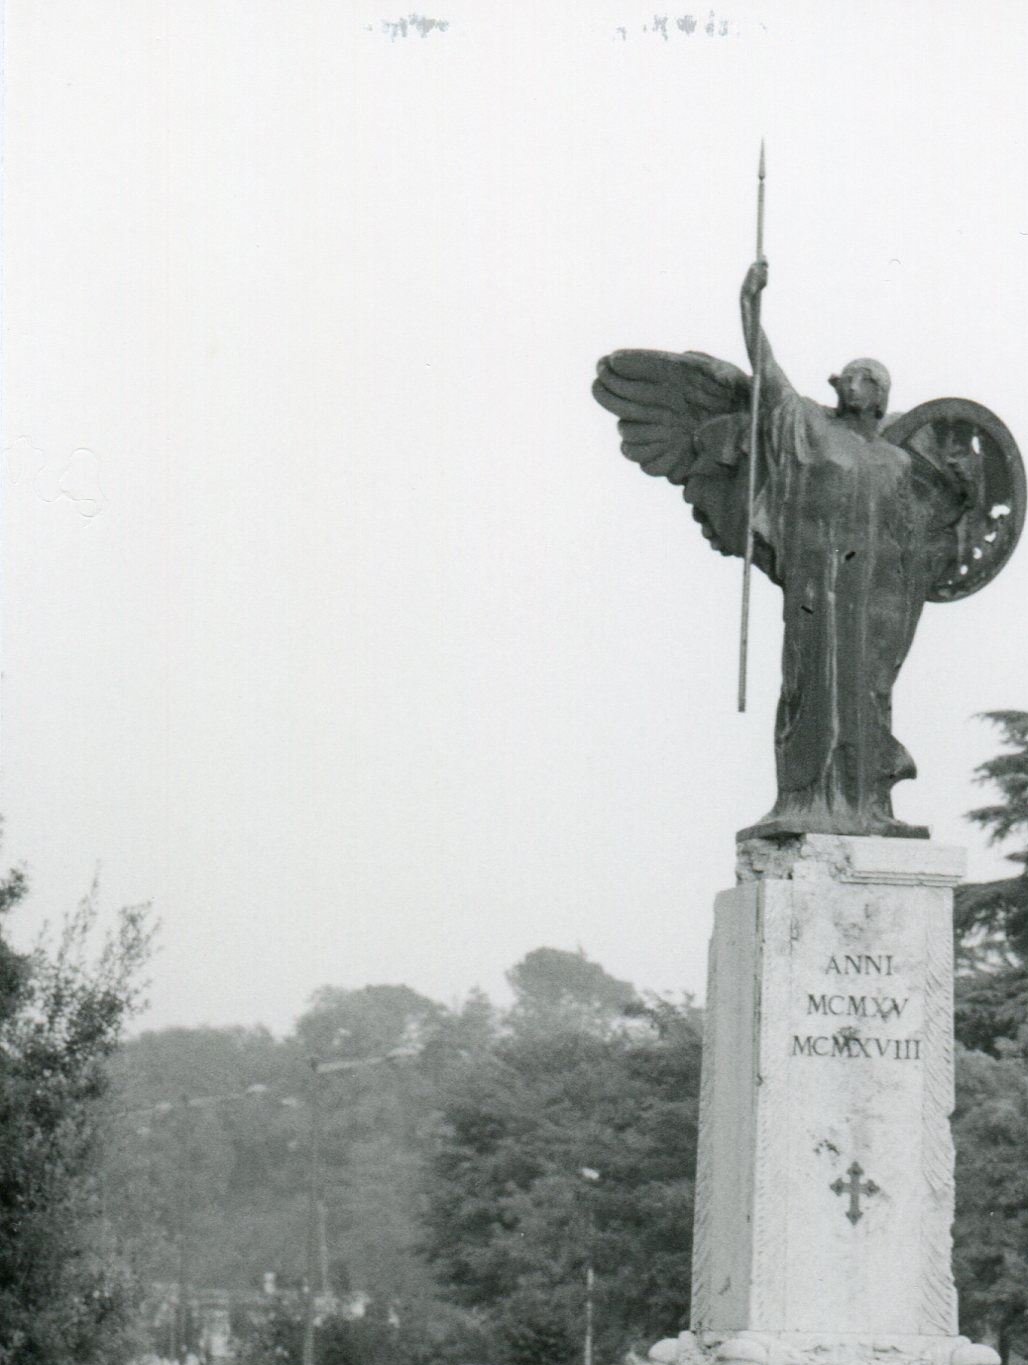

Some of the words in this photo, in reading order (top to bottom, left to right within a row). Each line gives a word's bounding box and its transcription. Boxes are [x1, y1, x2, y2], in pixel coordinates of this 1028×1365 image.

[824, 954, 893, 976] ANNI
[806, 994, 909, 1018] MCMXV
[792, 1035, 921, 1060] MCMXVIII
